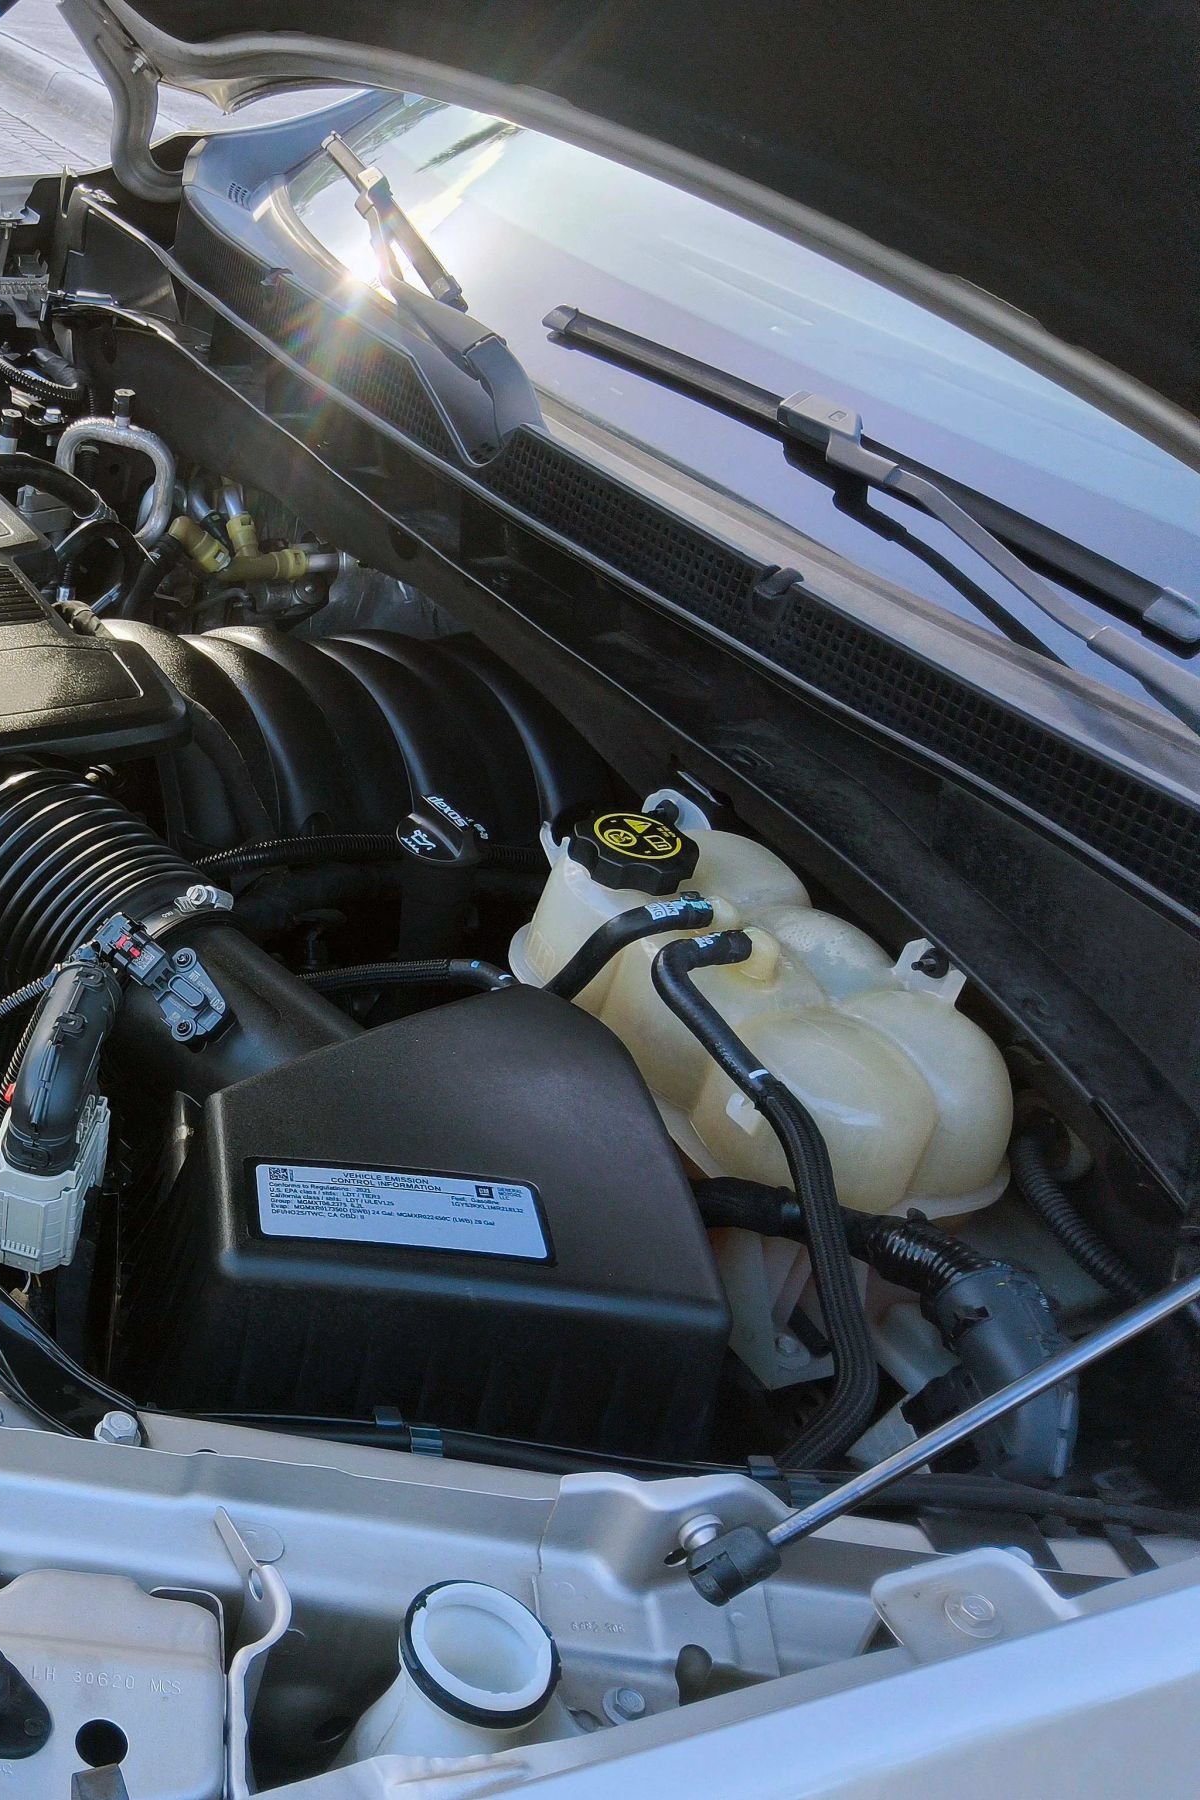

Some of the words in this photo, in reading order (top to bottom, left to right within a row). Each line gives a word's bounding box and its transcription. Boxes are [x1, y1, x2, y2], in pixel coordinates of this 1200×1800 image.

[427, 795, 468, 827] dexos
[331, 1177, 375, 1186] CONTROL
[378, 1181, 442, 1191] INFORMATION
[343, 1172, 382, 1180] VEHICLE
[384, 1175, 429, 1184] EMISSION
